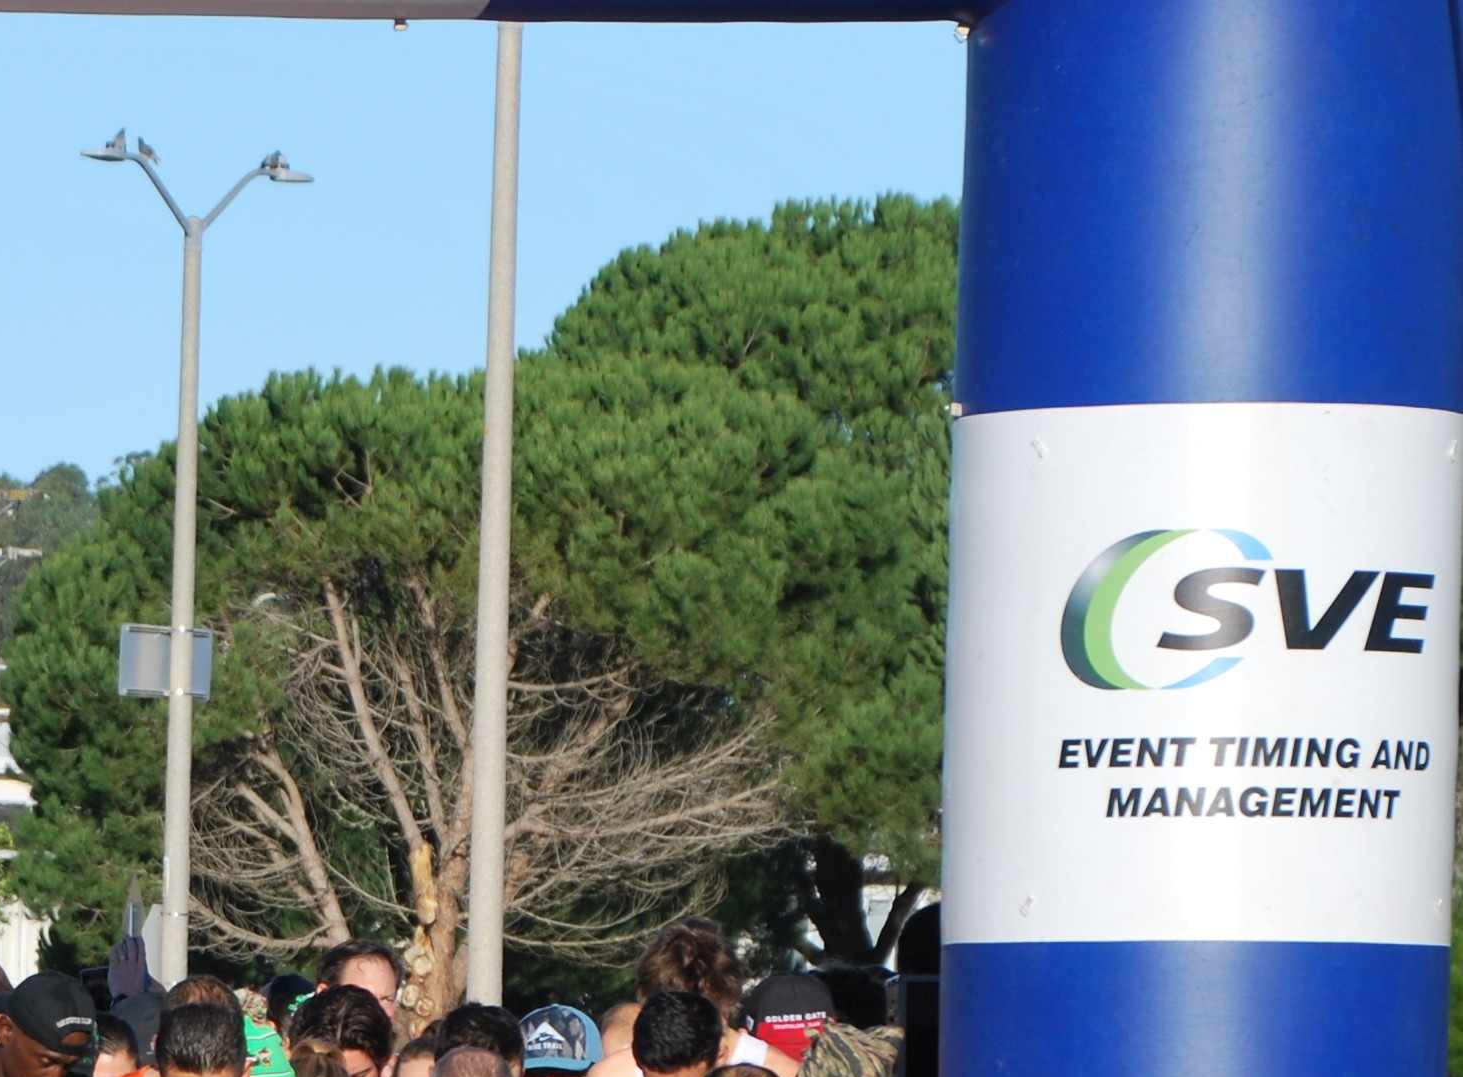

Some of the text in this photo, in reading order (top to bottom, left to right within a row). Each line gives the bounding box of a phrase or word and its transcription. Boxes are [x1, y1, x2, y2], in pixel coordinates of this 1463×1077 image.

[1156, 566, 1436, 654] SVE
[1058, 736, 1430, 771] EVENT TIMING AND
[1105, 786, 1401, 819] MANAGEMENT
[764, 1011, 827, 1024] GOLDEN GATE
